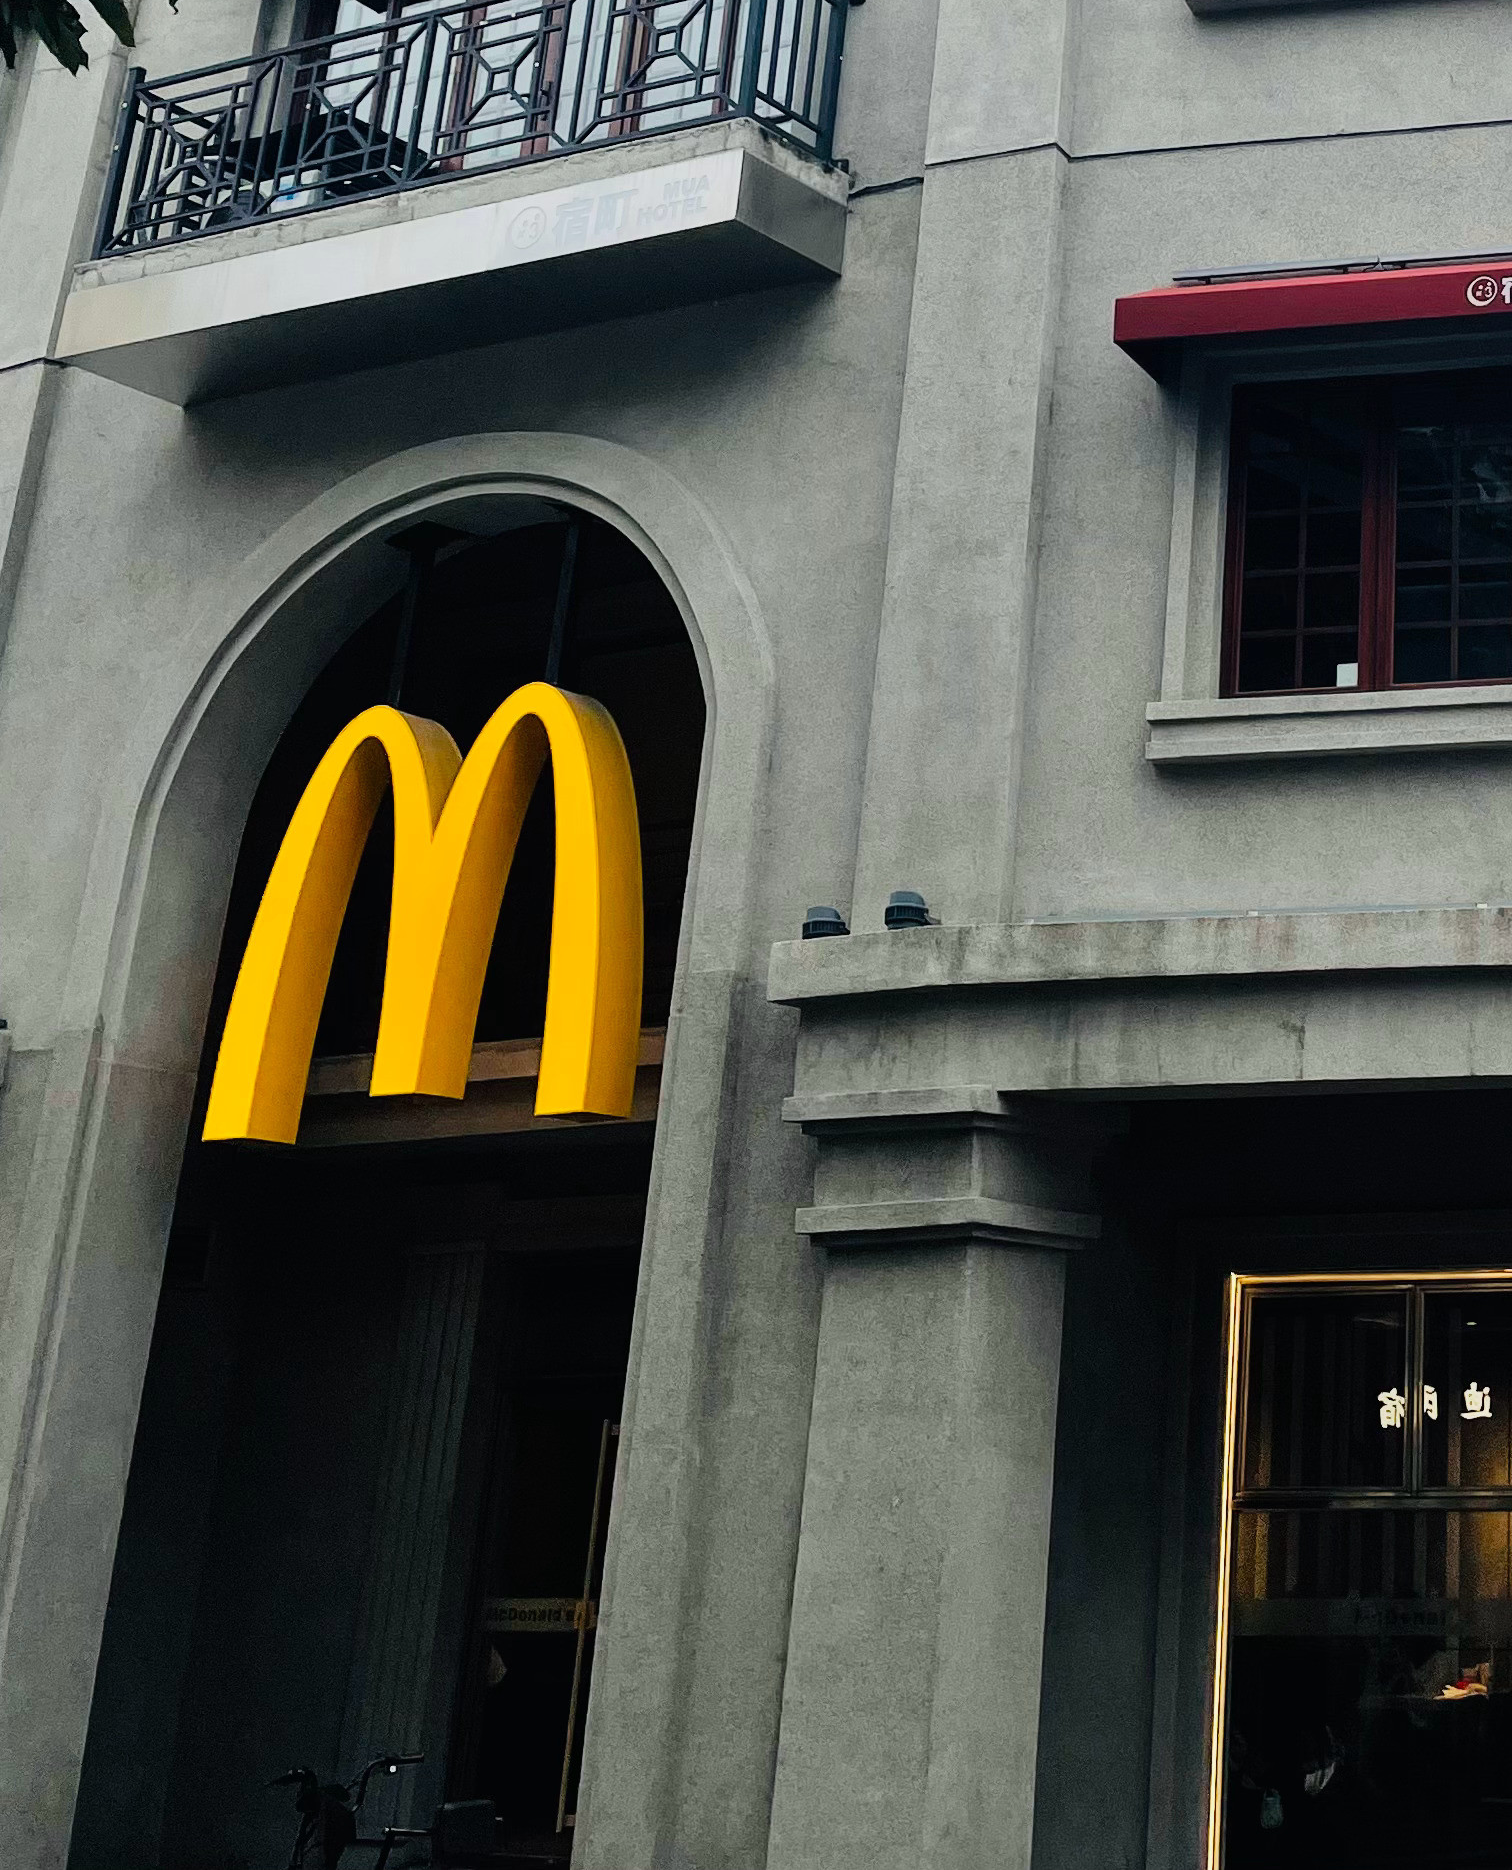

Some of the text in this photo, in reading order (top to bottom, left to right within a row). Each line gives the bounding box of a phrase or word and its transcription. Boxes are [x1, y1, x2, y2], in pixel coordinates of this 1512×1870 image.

[663, 175, 710, 203] MUA
[552, 188, 638, 249] 宿町
[637, 195, 708, 226] HOTEL
